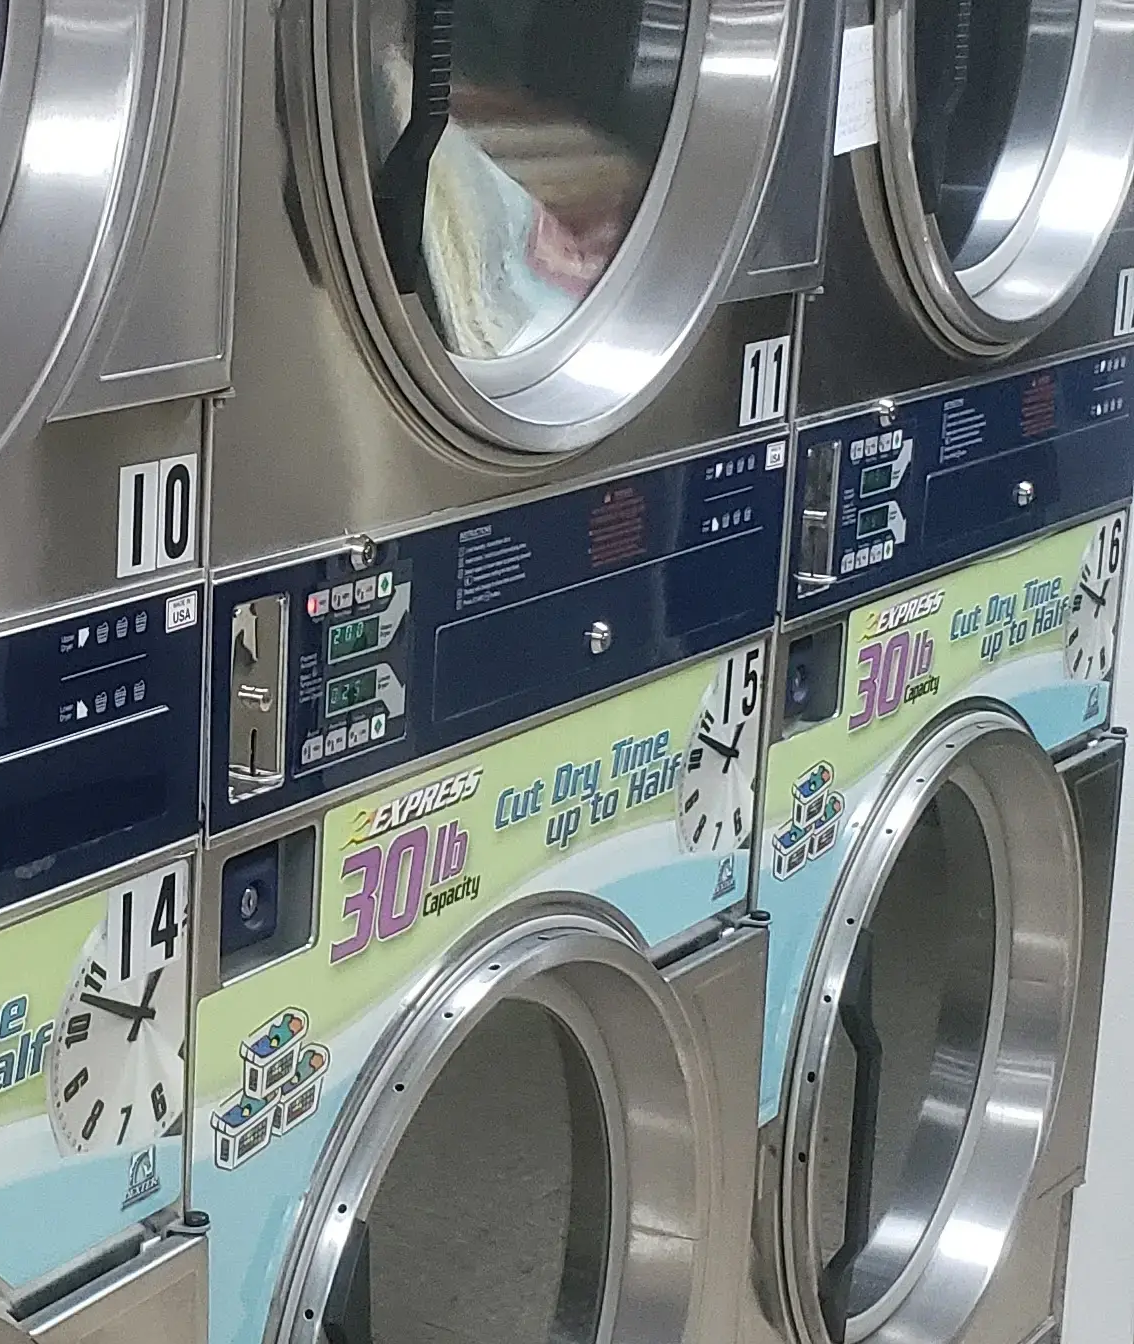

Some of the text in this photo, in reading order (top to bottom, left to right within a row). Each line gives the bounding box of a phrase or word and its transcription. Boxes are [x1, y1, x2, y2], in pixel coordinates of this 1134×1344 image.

[750, 344, 783, 420] 11
[132, 464, 190, 566] 10
[1097, 519, 1121, 579] 16
[172, 608, 190, 624] USA
[876, 588, 946, 636] EXPRESS
[949, 576, 1062, 642] Cut Dry Time
[980, 629, 1003, 664] up
[1008, 618, 1028, 646] to
[1031, 595, 1070, 638] Half
[723, 648, 759, 725] 15
[848, 628, 934, 734] 30 lb
[904, 674, 940, 704] Capacity
[370, 764, 484, 836] EXPRESS
[494, 728, 670, 832] Cut Dry Time
[545, 751, 684, 850] up to Half
[121, 872, 178, 981] 14
[330, 818, 468, 966] 30 lb
[422, 874, 480, 917] Capacity
